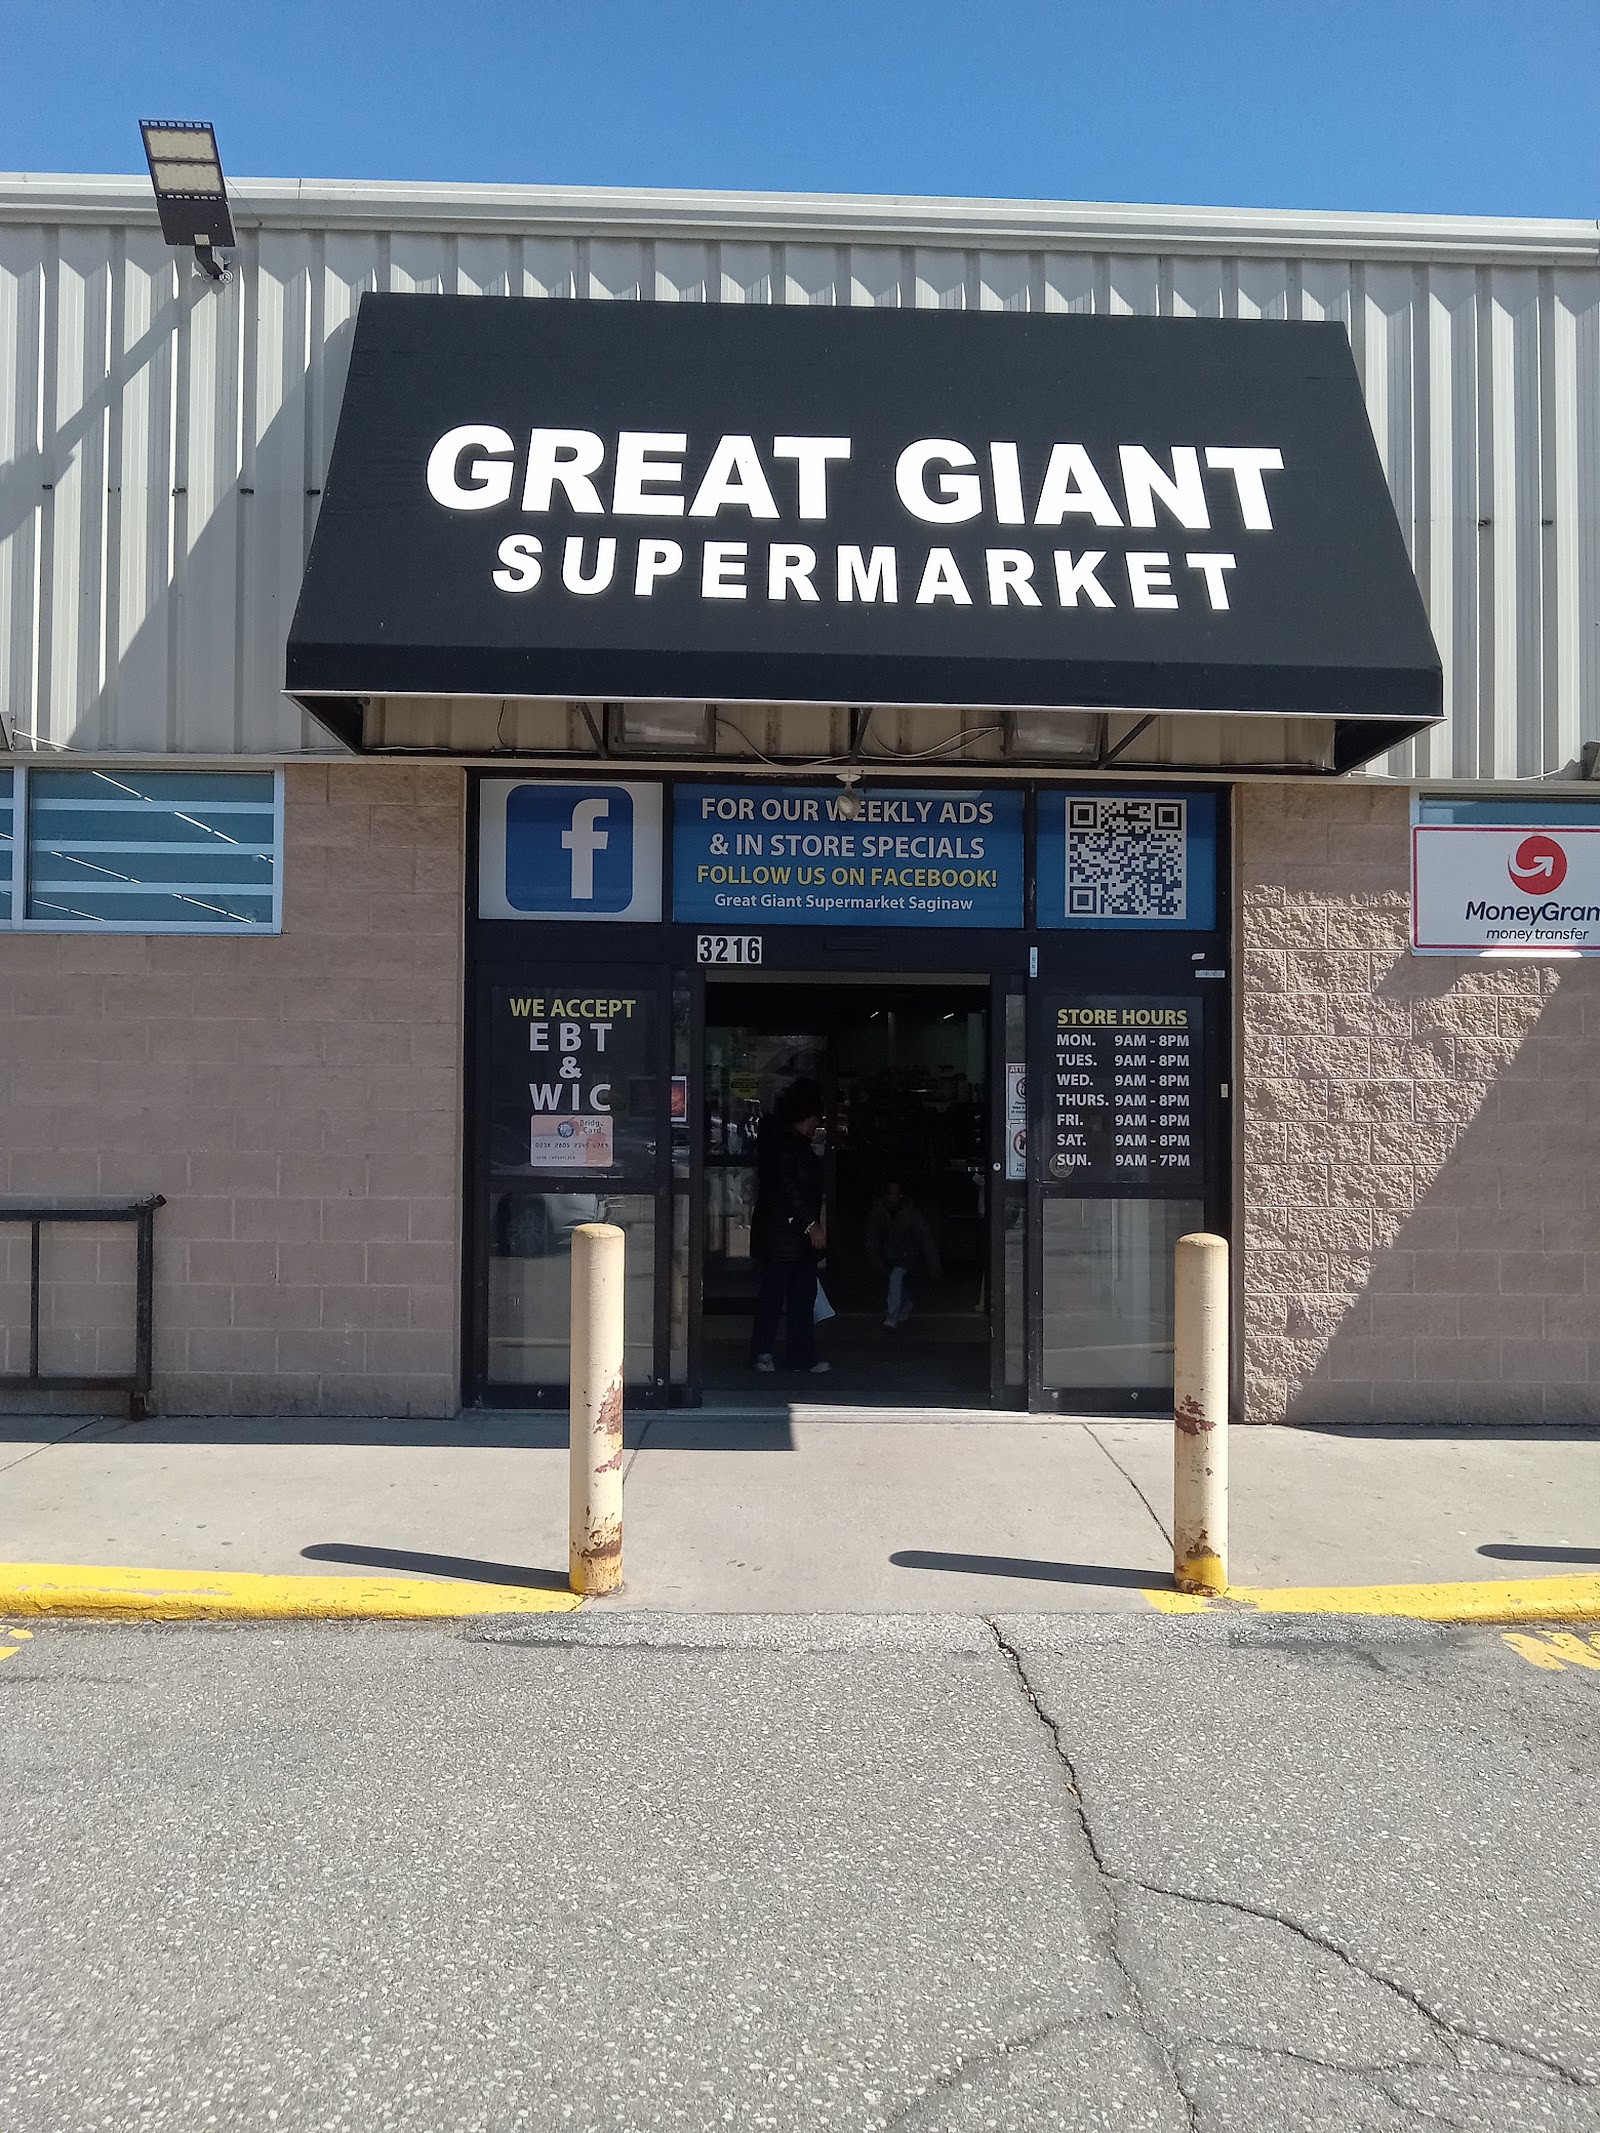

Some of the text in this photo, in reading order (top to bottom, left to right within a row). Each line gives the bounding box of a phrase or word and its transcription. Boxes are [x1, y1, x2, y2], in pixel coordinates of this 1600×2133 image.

[426, 423, 1286, 531] GREAT GIANT
[491, 532, 1237, 611] SUPERMARKET
[701, 797, 995, 825] FOR OUR WEEKLY ADS
[709, 833, 985, 860] & IN STORE SPECIALS
[698, 865, 997, 888] FOLLOW US ON FACEBOOK!
[714, 893, 973, 912] Great Giant Supermarket Saginaw
[1486, 927, 1589, 942] money transfer
[699, 937, 760, 962] 3216
[509, 998, 636, 1018] WE ACCEPT
[1057, 1008, 1188, 1026] STORE HOURS
[529, 1022, 613, 1052] EBT
[1057, 1033, 1096, 1047] MON.
[1114, 1034, 1147, 1047] 9AM
[1158, 1034, 1190, 1047] 8PM
[558, 1056, 583, 1079] &
[1056, 1053, 1098, 1067] TUES.
[1114, 1054, 1147, 1067] 9AM
[1158, 1054, 1190, 1067] 8PM
[1056, 1073, 1094, 1087] WED.
[1114, 1074, 1147, 1087] 9AM
[1158, 1074, 1190, 1087] 8PM
[528, 1083, 611, 1112] WIC
[1056, 1093, 1109, 1107] THURS.
[1114, 1094, 1147, 1107] 9AM
[1158, 1094, 1190, 1107] 8PM
[1057, 1113, 1084, 1127] FRI.
[1114, 1114, 1148, 1127] 9AM
[1159, 1114, 1191, 1127] 8PM
[1057, 1133, 1087, 1147] SAT.
[1114, 1134, 1148, 1147] 9AM
[1159, 1134, 1191, 1147] 8PM
[1057, 1153, 1092, 1167] SUN.
[1114, 1154, 1148, 1167] 9AM
[1159, 1154, 1191, 1167] 7PM
